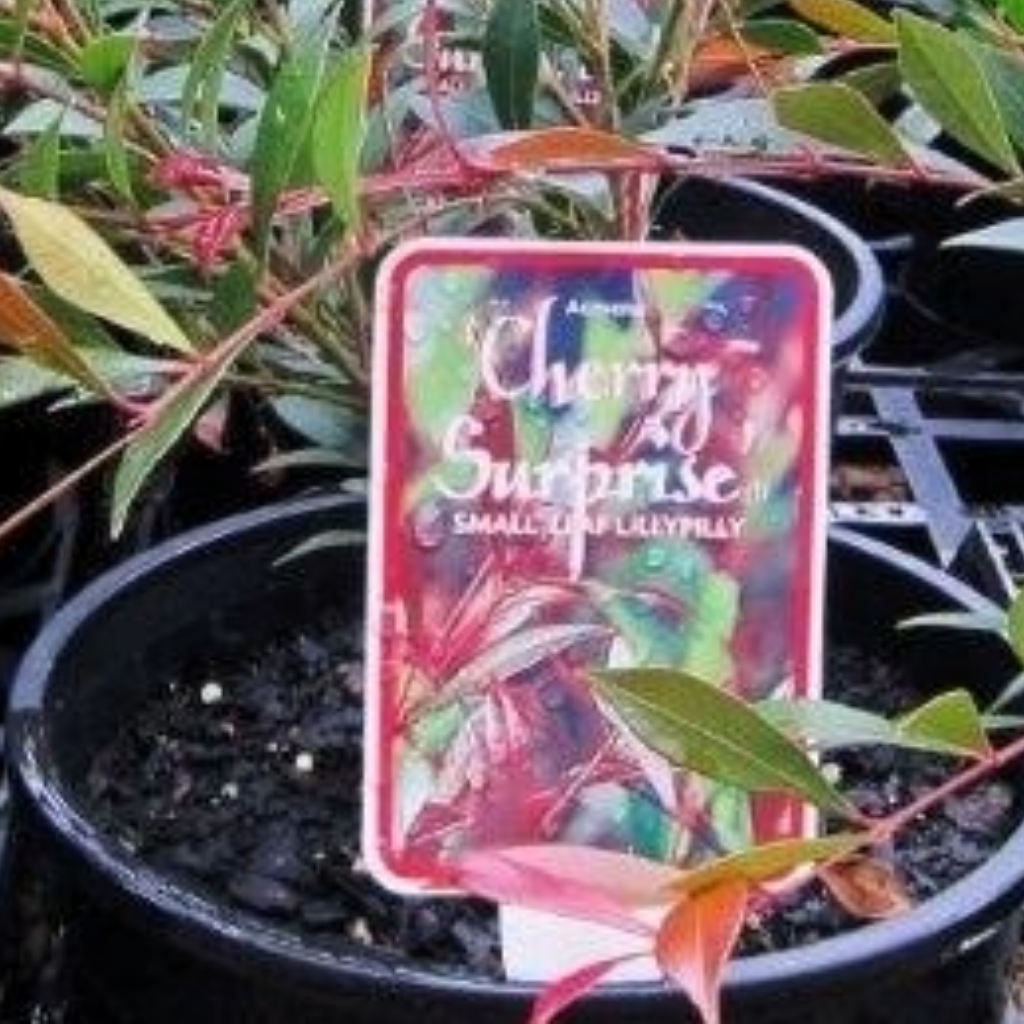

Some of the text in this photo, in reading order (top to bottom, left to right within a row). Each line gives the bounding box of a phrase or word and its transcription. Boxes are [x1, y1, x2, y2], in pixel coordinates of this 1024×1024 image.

[482, 296, 719, 460] Cherry
[434, 414, 742, 568] Surprise
[453, 513, 537, 535] SMALL
